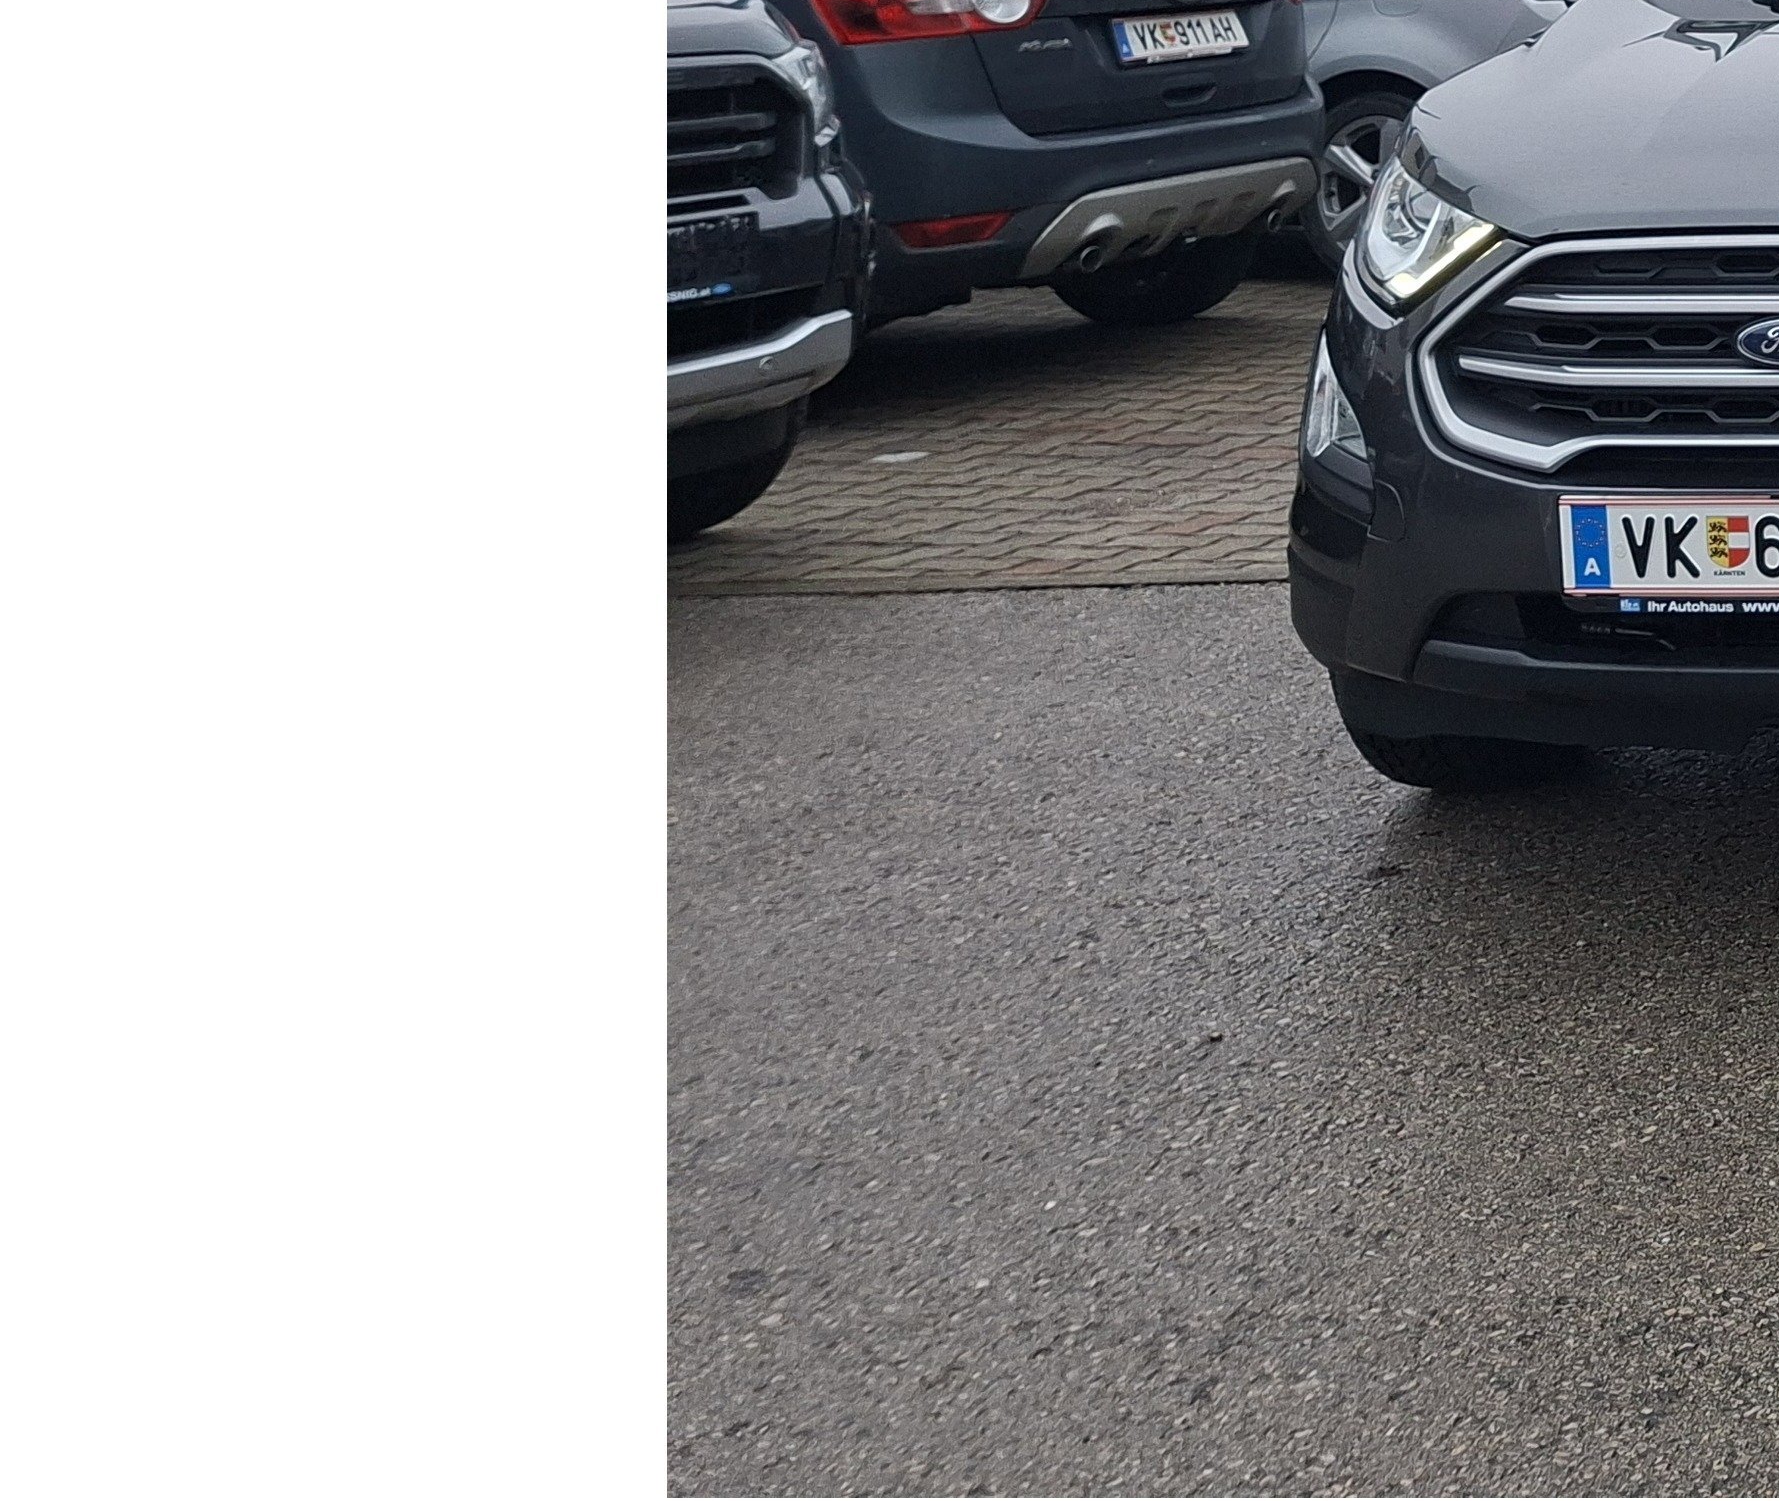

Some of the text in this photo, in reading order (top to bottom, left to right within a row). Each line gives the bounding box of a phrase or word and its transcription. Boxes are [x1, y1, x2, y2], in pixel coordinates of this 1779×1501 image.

[1133, 16, 1238, 49] VK 911 AH
[1621, 515, 1701, 579] VK
[1584, 557, 1602, 576] A
[1647, 600, 1667, 612] Ihr
[1668, 600, 1734, 613] Autohaus
